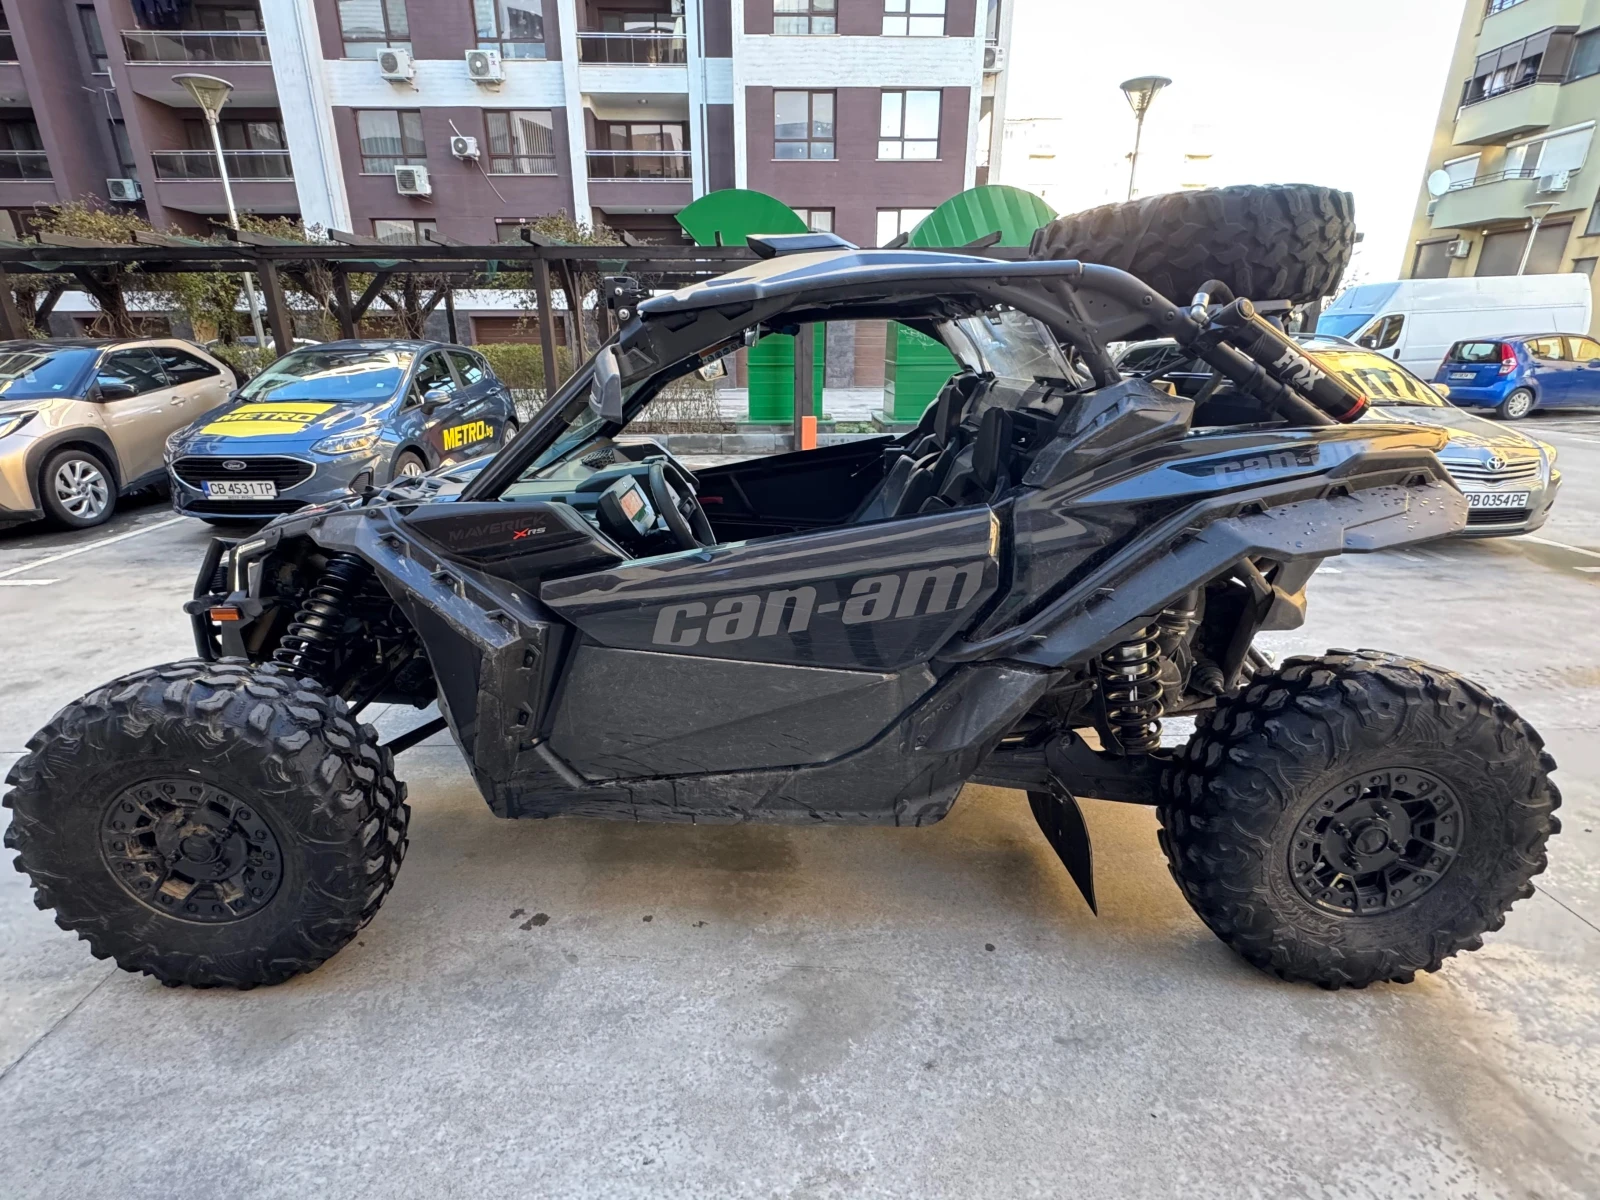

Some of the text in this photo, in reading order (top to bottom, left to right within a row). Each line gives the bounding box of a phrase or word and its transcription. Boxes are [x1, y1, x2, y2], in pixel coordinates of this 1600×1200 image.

[1271, 346, 1327, 392] FOX
[214, 412, 317, 423] METRO
[442, 420, 494, 451] METRO.bg
[210, 483, 273, 495] CB 4531 TP
[1482, 494, 1511, 506] 0354
[1511, 494, 1526, 506] PE
[448, 513, 546, 541] MAVERICK
[651, 561, 985, 647] can-am
